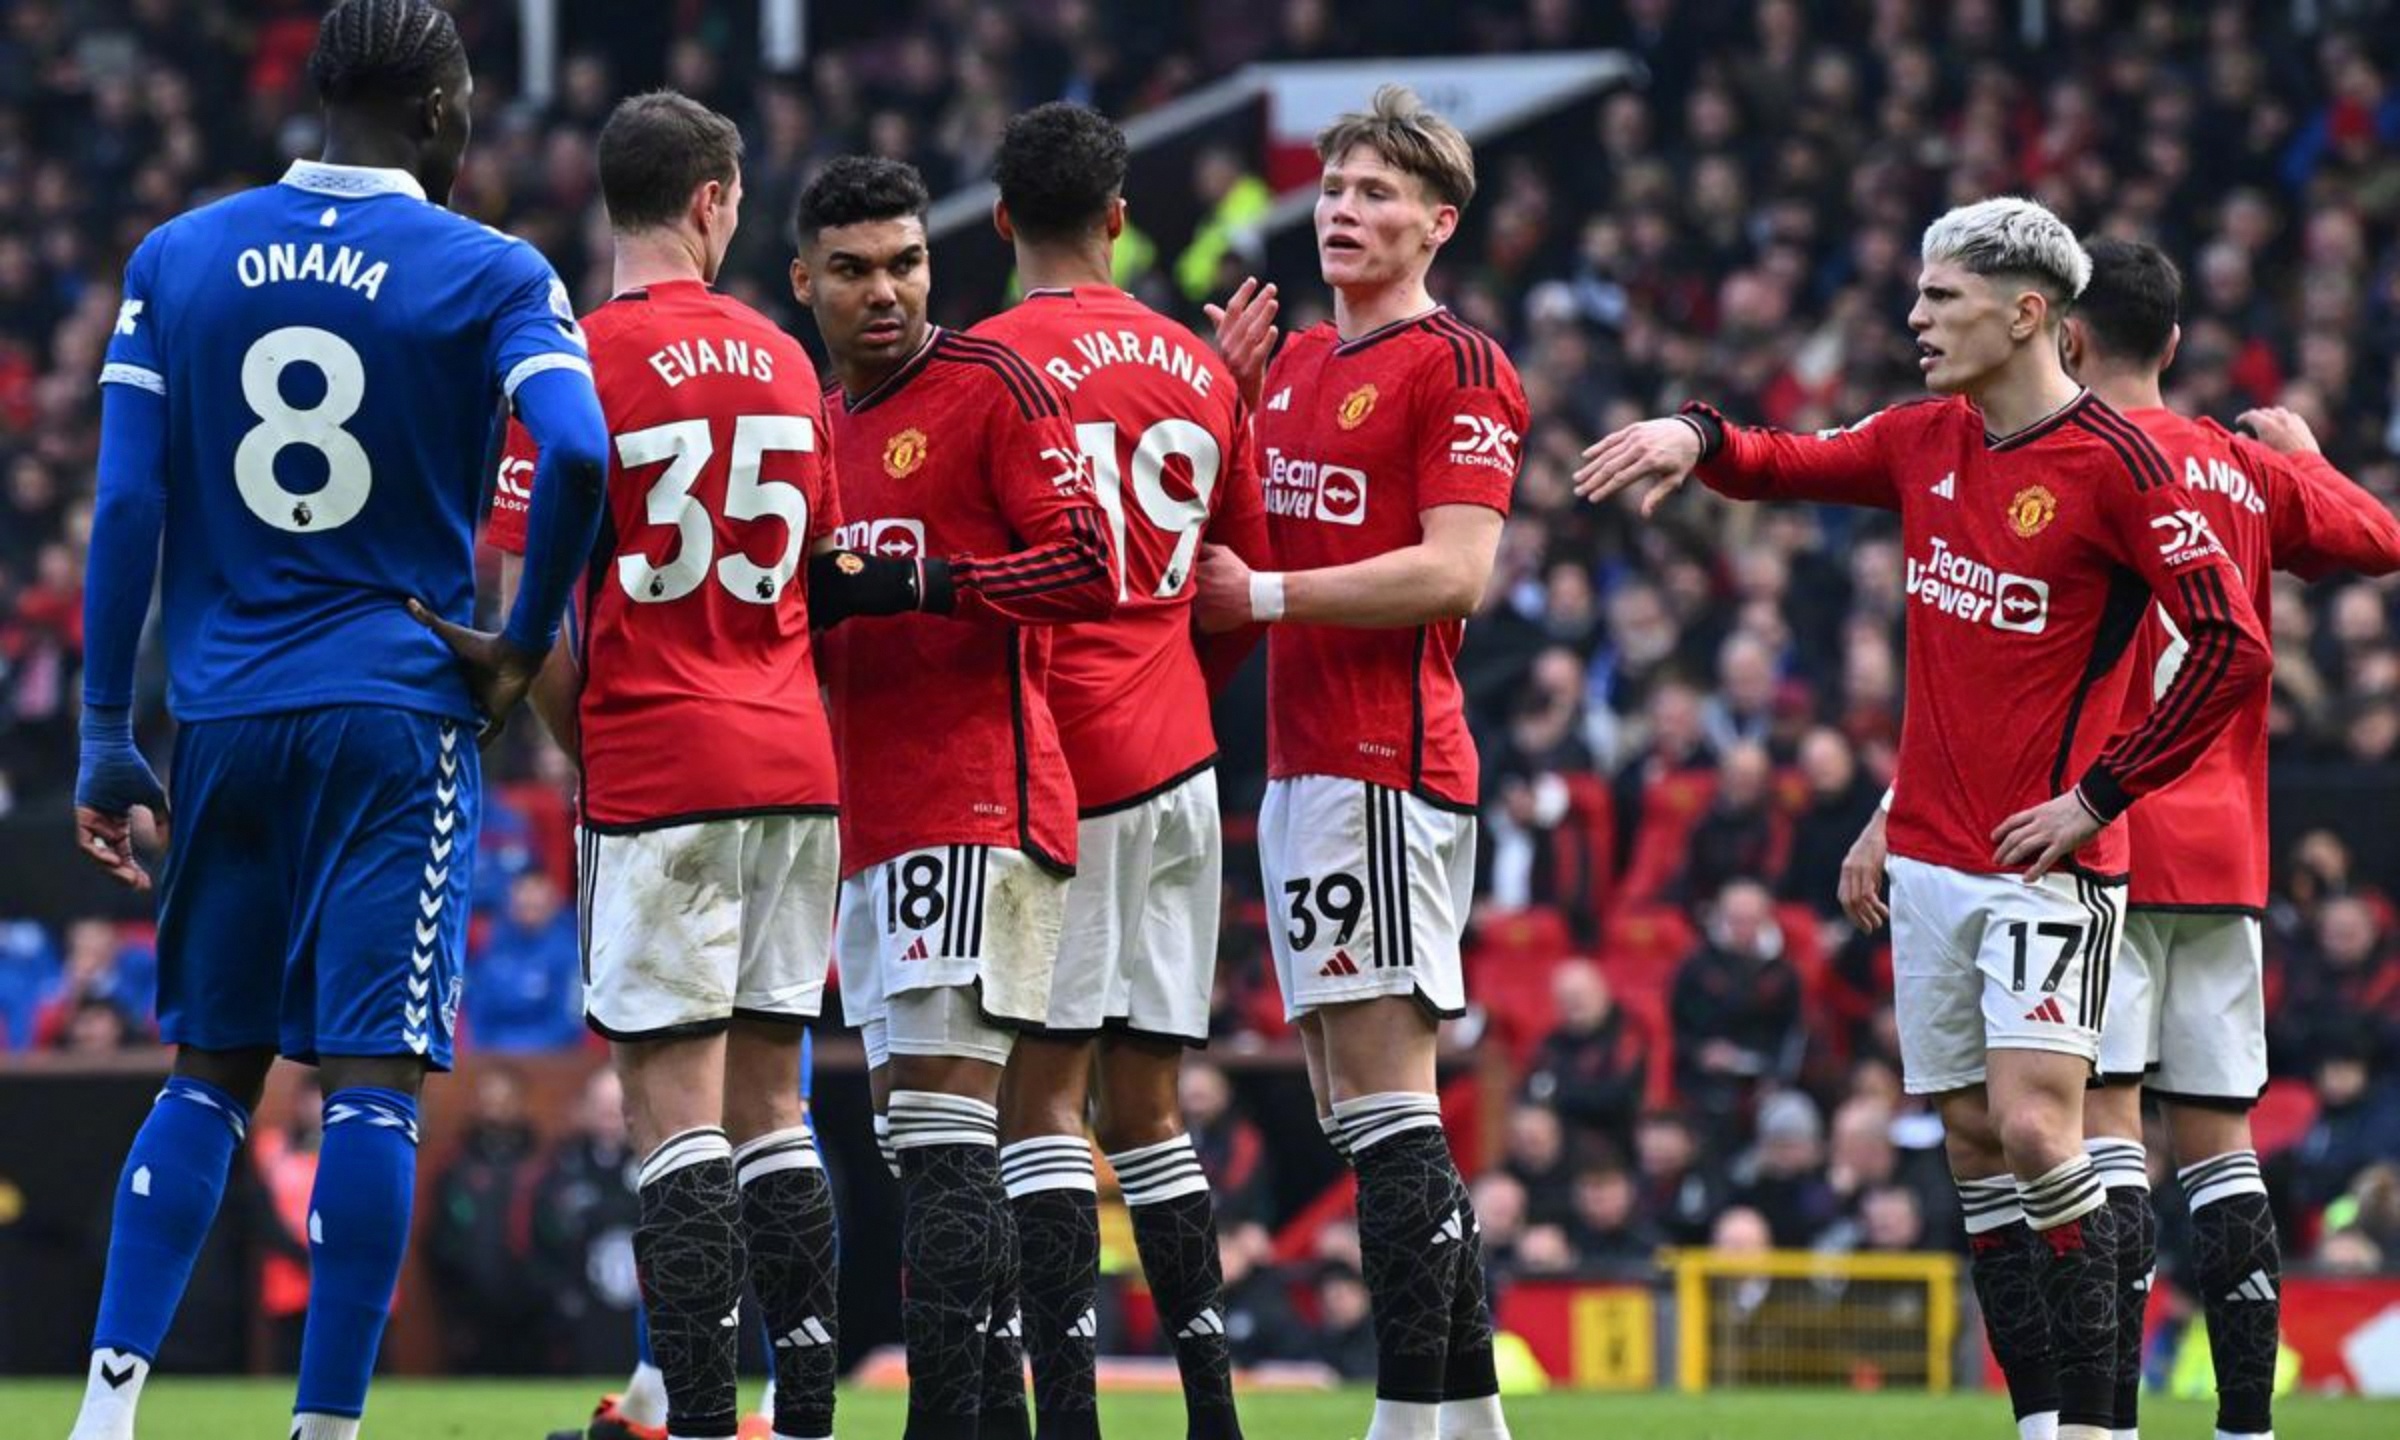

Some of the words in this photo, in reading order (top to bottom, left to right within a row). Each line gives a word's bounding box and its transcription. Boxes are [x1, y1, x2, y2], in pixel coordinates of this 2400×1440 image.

[237, 243, 388, 301] ONANA
[648, 338, 773, 388] EVANS
[1045, 330, 1212, 396] R.VARANE
[234, 325, 372, 533] 8
[1265, 447, 1317, 488] Team
[615, 415, 814, 604] 35
[834, 521, 869, 550] am
[1075, 418, 1221, 603] 19
[1928, 536, 1994, 595] Team
[886, 854, 944, 934] 18
[1285, 872, 1364, 952] 39
[2008, 921, 2083, 992] 17
